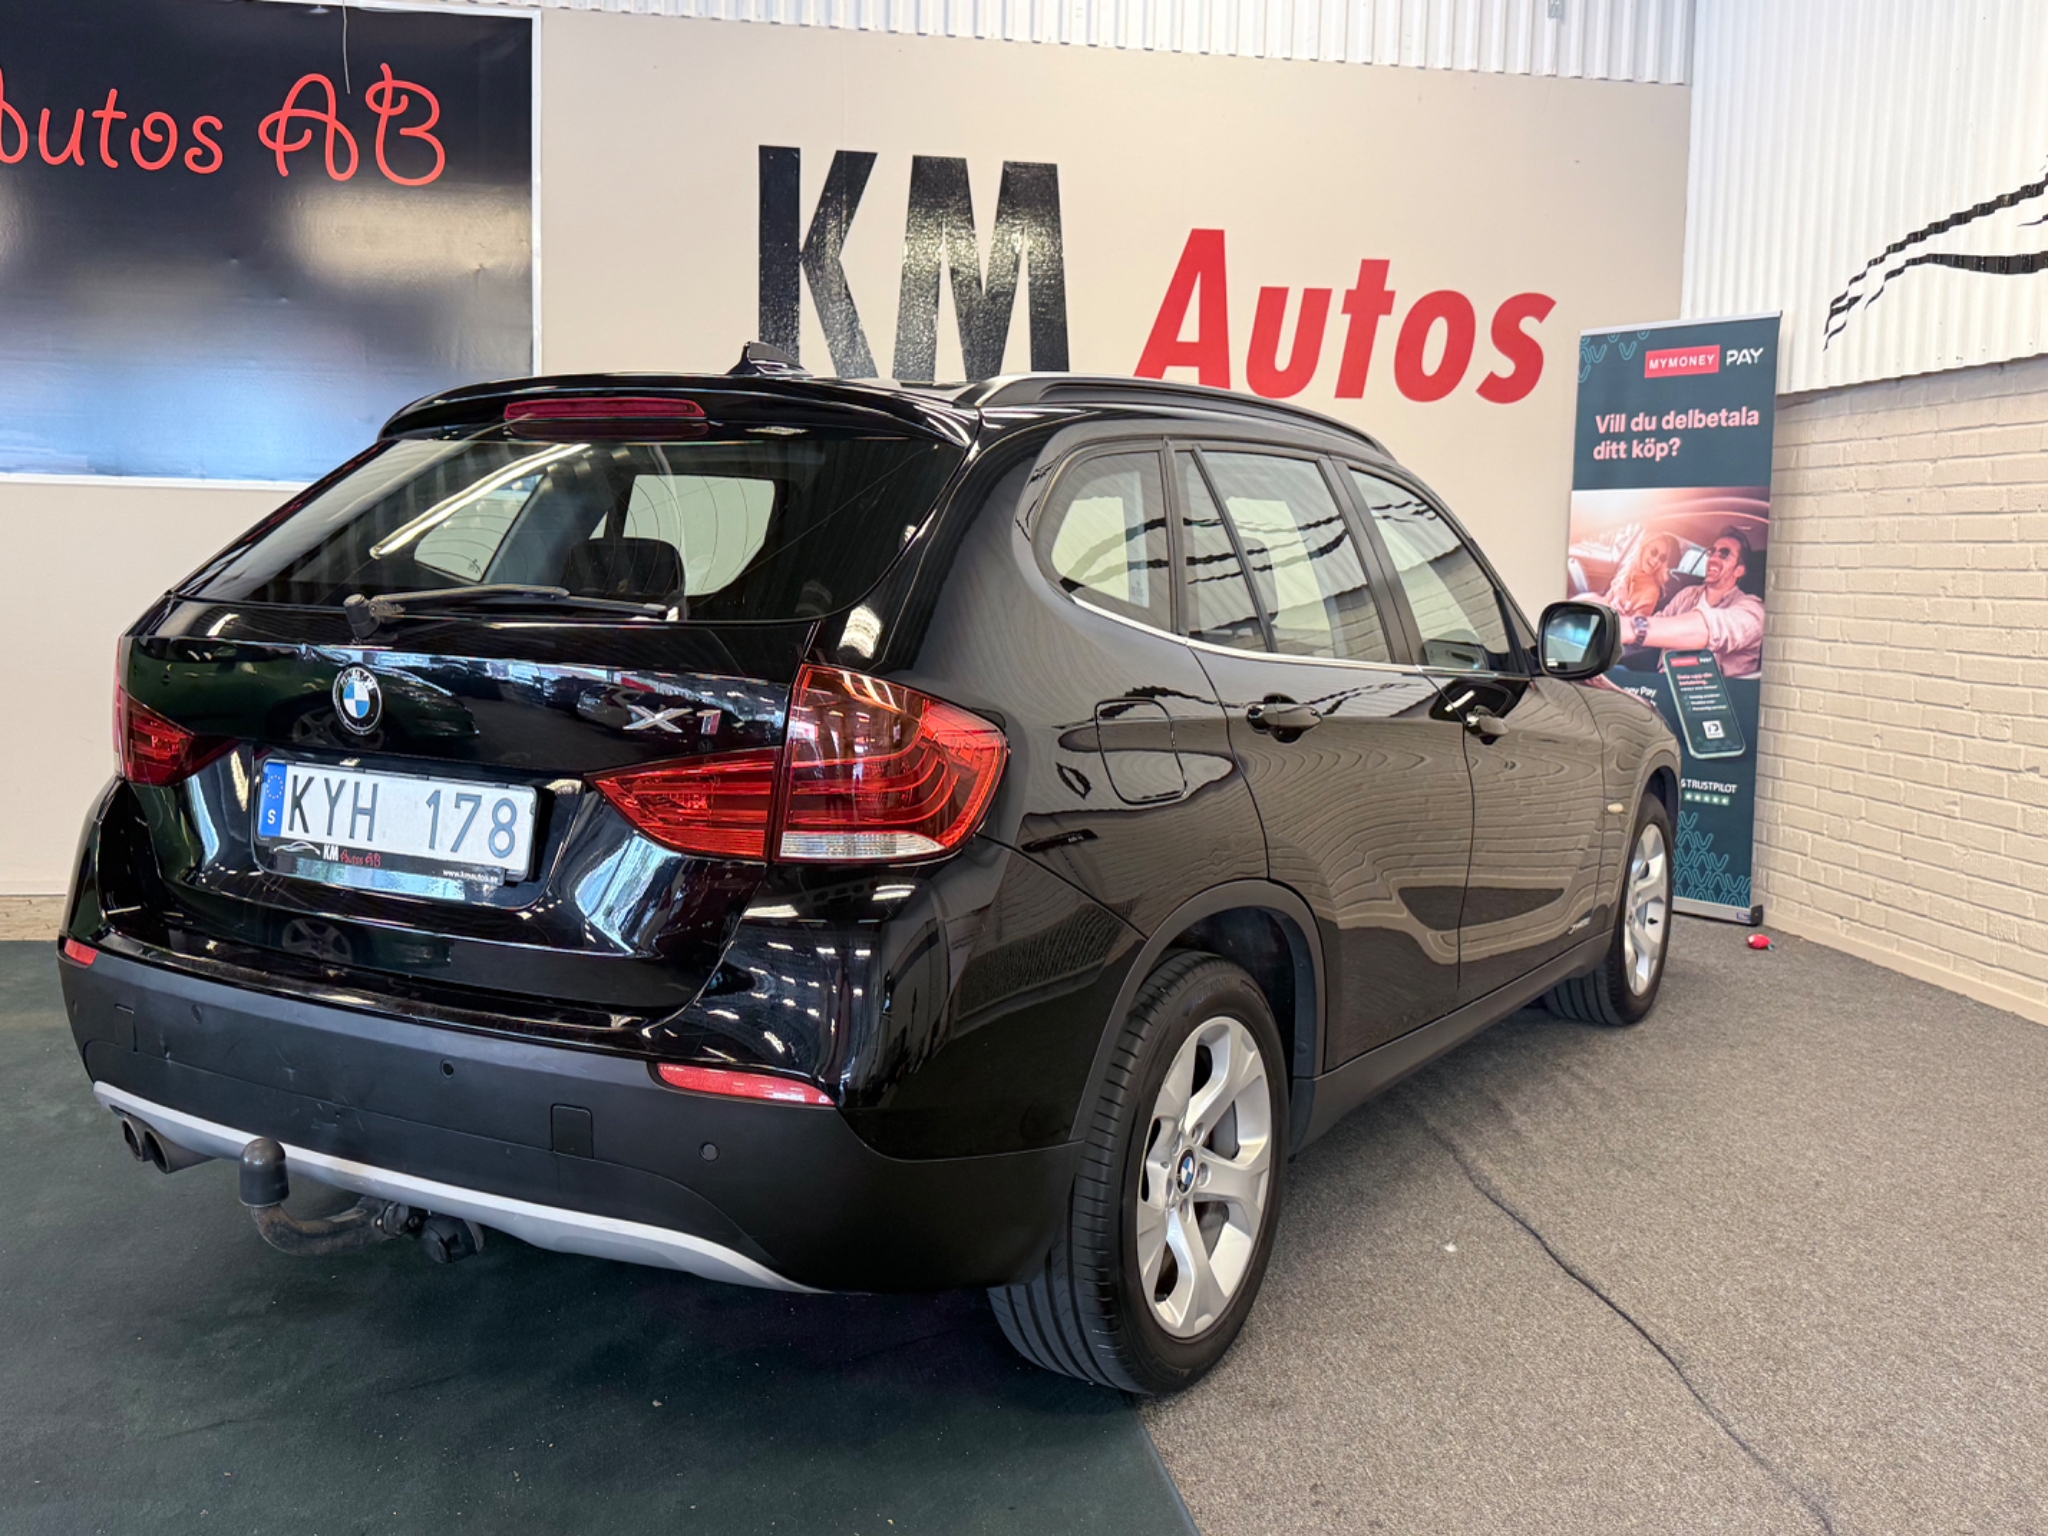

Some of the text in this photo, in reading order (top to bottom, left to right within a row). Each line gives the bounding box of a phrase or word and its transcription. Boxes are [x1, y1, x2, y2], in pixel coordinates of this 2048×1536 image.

[258, 63, 446, 186] AB
[758, 144, 1556, 405] KM Autos
[1648, 347, 1764, 371] MYMONEY PAY
[1595, 406, 1760, 434] Vill du delbetala
[1593, 437, 1682, 463] ditt köp?
[622, 704, 722, 735] X1
[1686, 779, 1738, 794] TRUSTPILOT
[266, 774, 518, 860] S KYH 178
[323, 844, 381, 868] KM Autos AB
